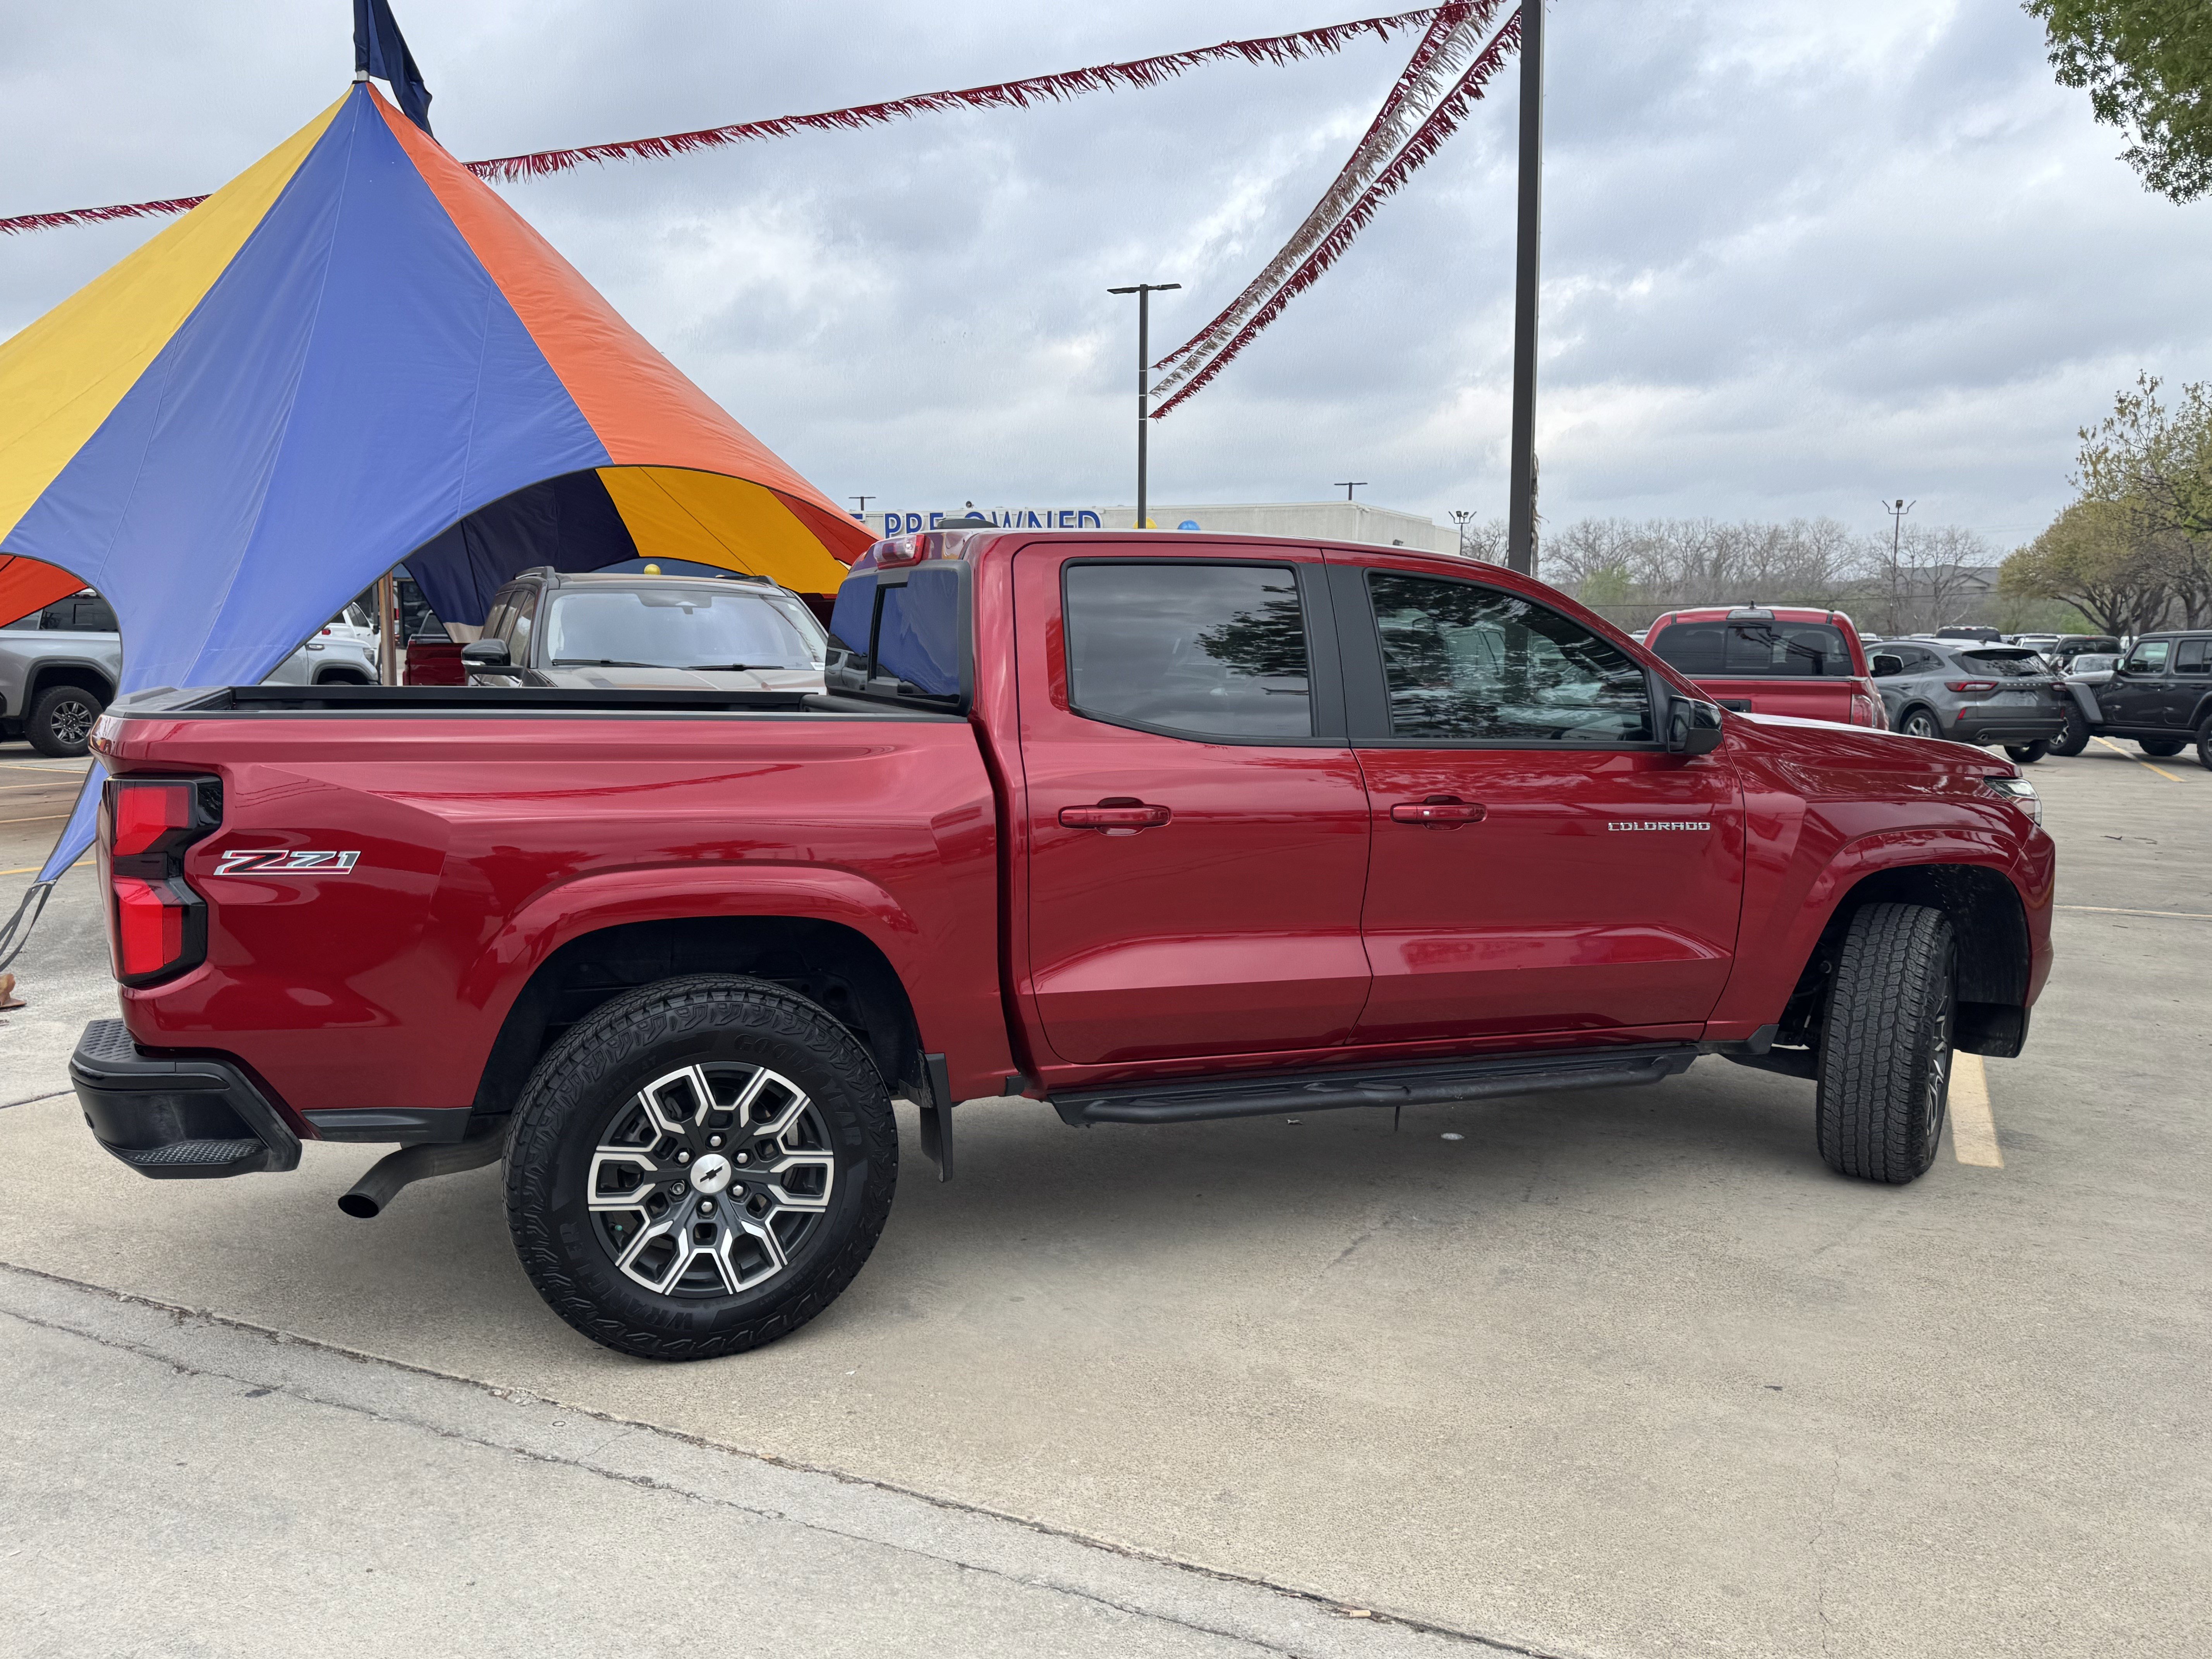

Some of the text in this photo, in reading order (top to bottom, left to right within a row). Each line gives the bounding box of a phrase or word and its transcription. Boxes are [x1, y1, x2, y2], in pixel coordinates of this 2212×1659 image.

[1608, 822, 1711, 831] COLORADO
[213, 850, 361, 876] Z71
[733, 1033, 862, 1146] GOODYEAR
[560, 1222, 694, 1331] WRANGLER
